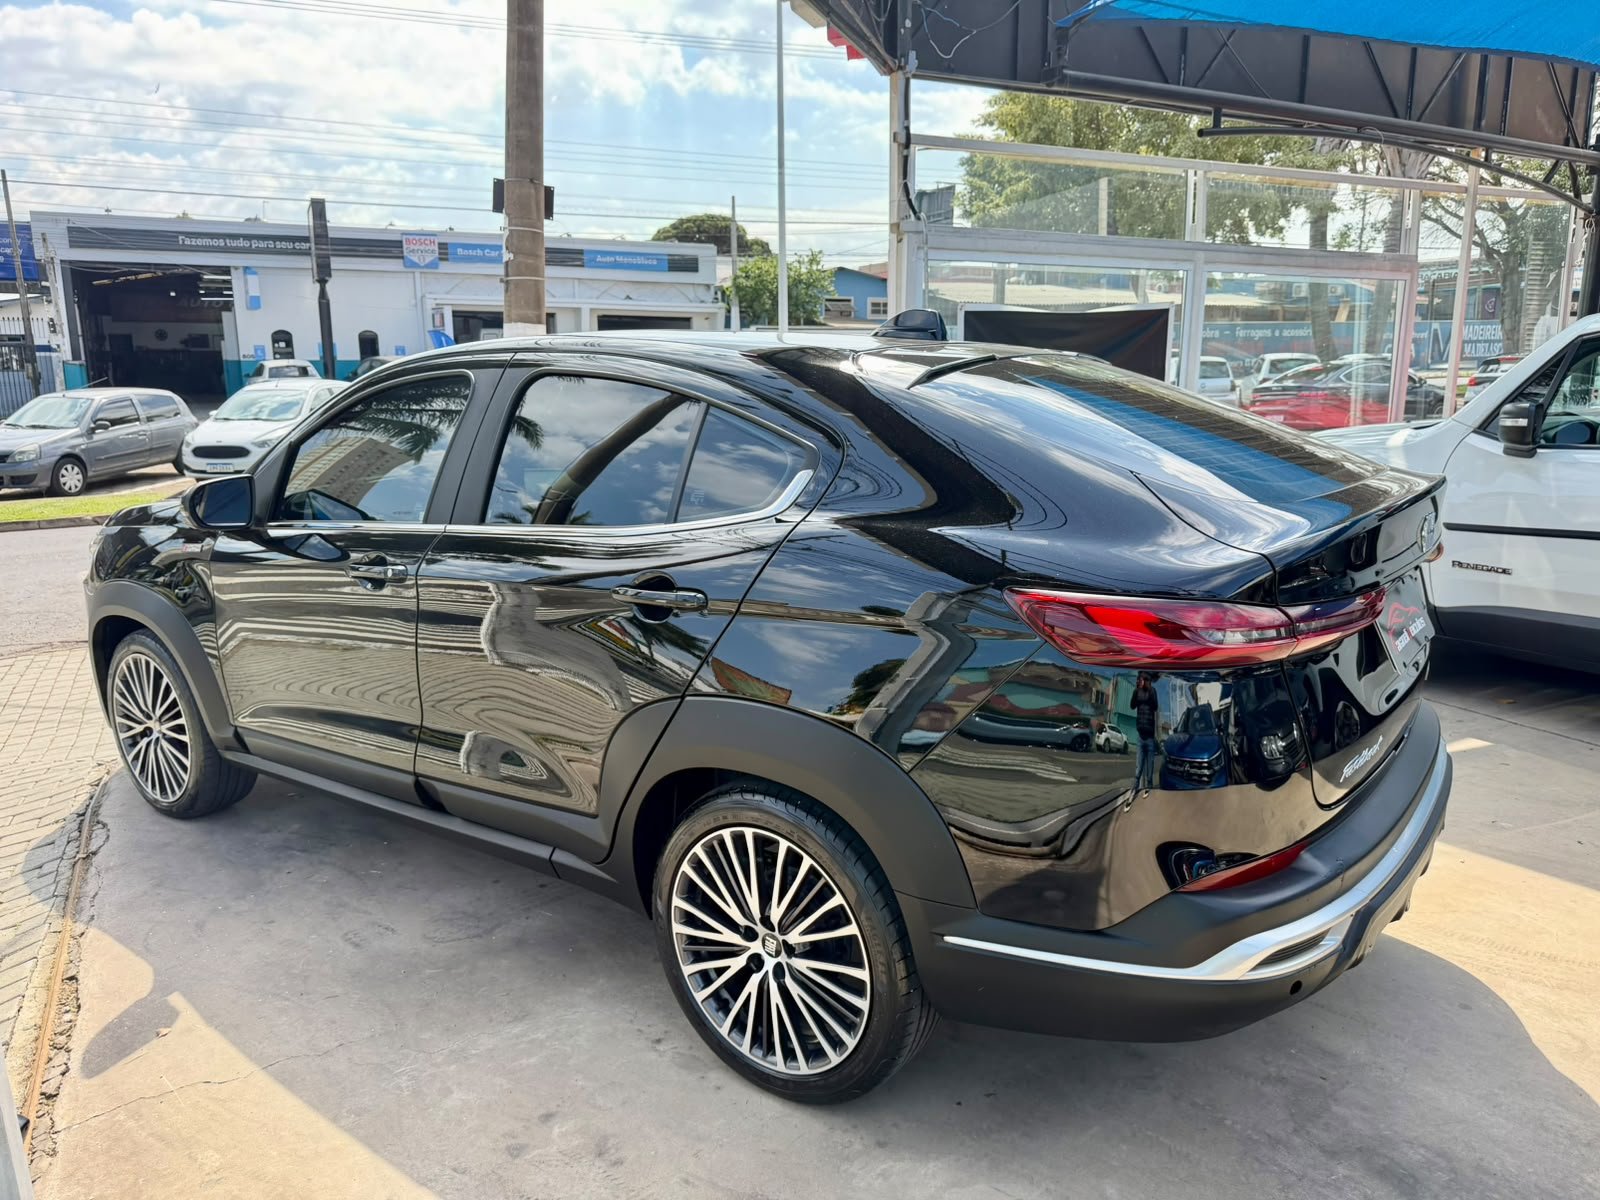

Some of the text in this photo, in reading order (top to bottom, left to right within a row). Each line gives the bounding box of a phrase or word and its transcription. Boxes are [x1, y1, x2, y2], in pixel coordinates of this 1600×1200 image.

[178, 235, 225, 247] Fazemos
[226, 237, 250, 248] tudo
[251, 239, 275, 249] para
[275, 241, 294, 249] seu
[405, 237, 436, 246] BOSCH
[405, 246, 437, 255] Service
[456, 247, 484, 257] Bosch
[484, 249, 500, 257] Car
[1235, 327, 1272, 340] Ferragens
[1451, 560, 1512, 576] RENEGADE
